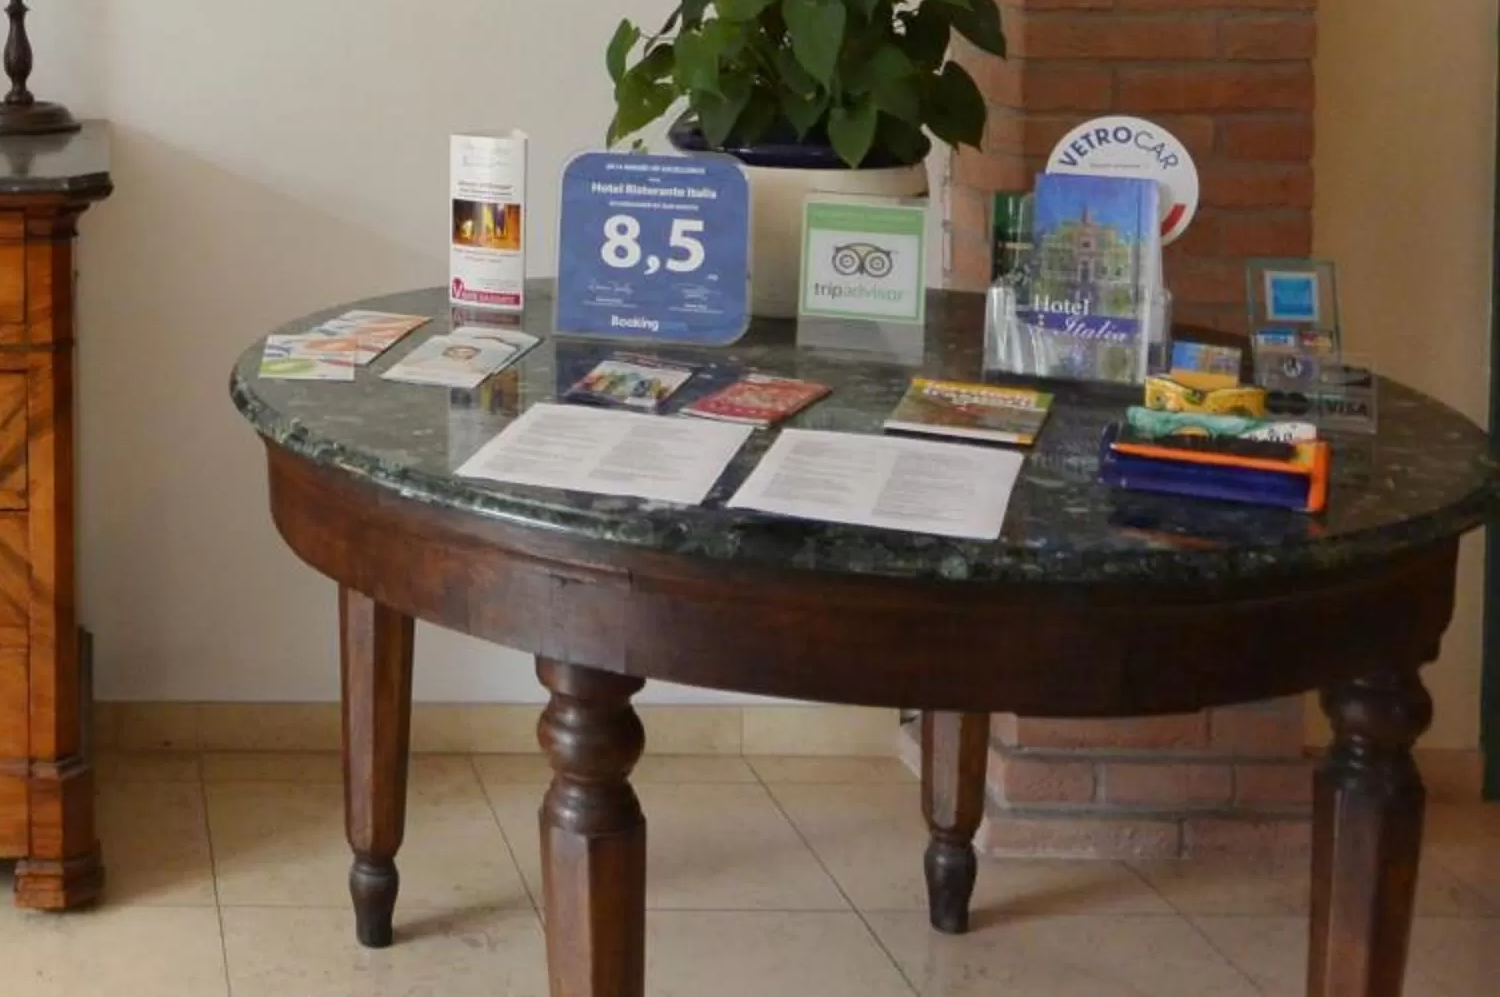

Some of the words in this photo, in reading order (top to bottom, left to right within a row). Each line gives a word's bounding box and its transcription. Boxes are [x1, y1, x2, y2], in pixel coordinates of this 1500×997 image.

[1058, 126, 1179, 170] VETROCAR
[591, 181, 623, 195] Hotel
[626, 183, 685, 198] Ristorante
[687, 187, 717, 199] Italia
[601, 215, 706, 275] 8,5
[814, 282, 904, 301] tripadvisor
[1034, 294, 1089, 315] Hotel
[1053, 317, 1128, 341] Italia
